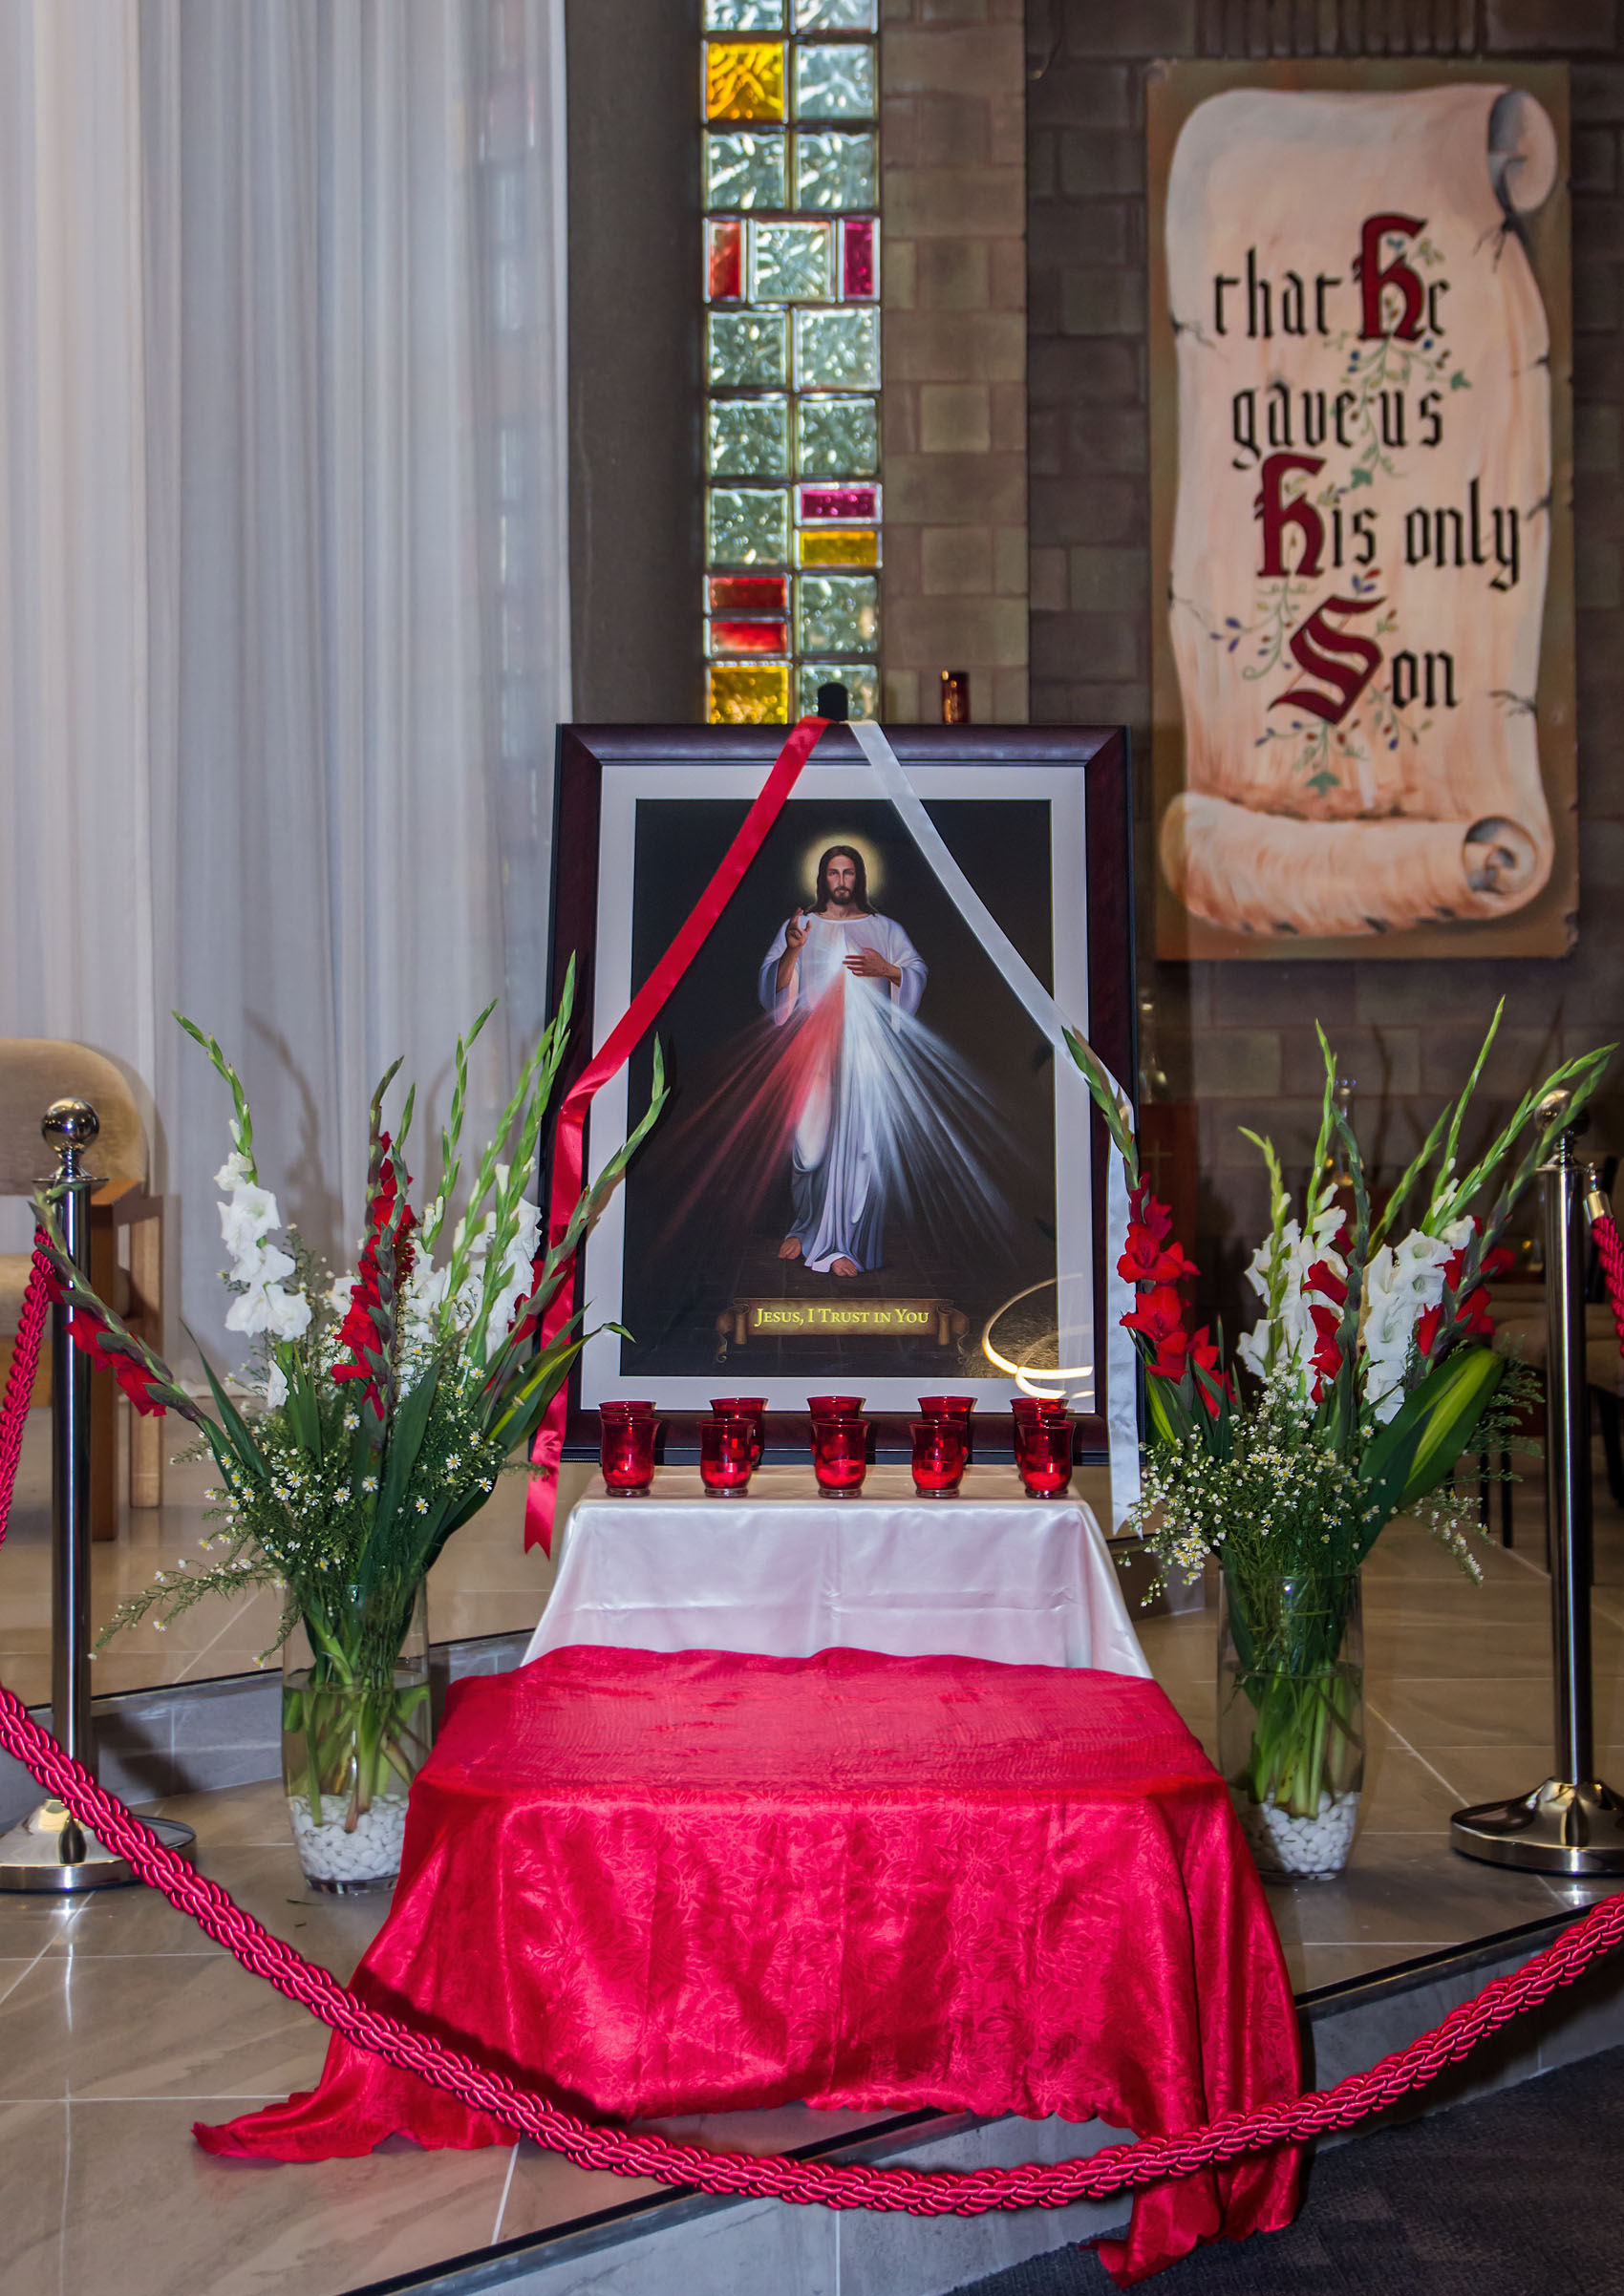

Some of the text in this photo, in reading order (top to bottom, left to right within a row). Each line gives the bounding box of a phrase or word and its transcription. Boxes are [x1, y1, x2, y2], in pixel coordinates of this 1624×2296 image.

[1231, 379, 1443, 471] gave us
[1253, 451, 1521, 592] His only
[1267, 593, 1461, 726] Son
[807, 1307, 815, 1323] I
[818, 1307, 870, 1324] TRUST
